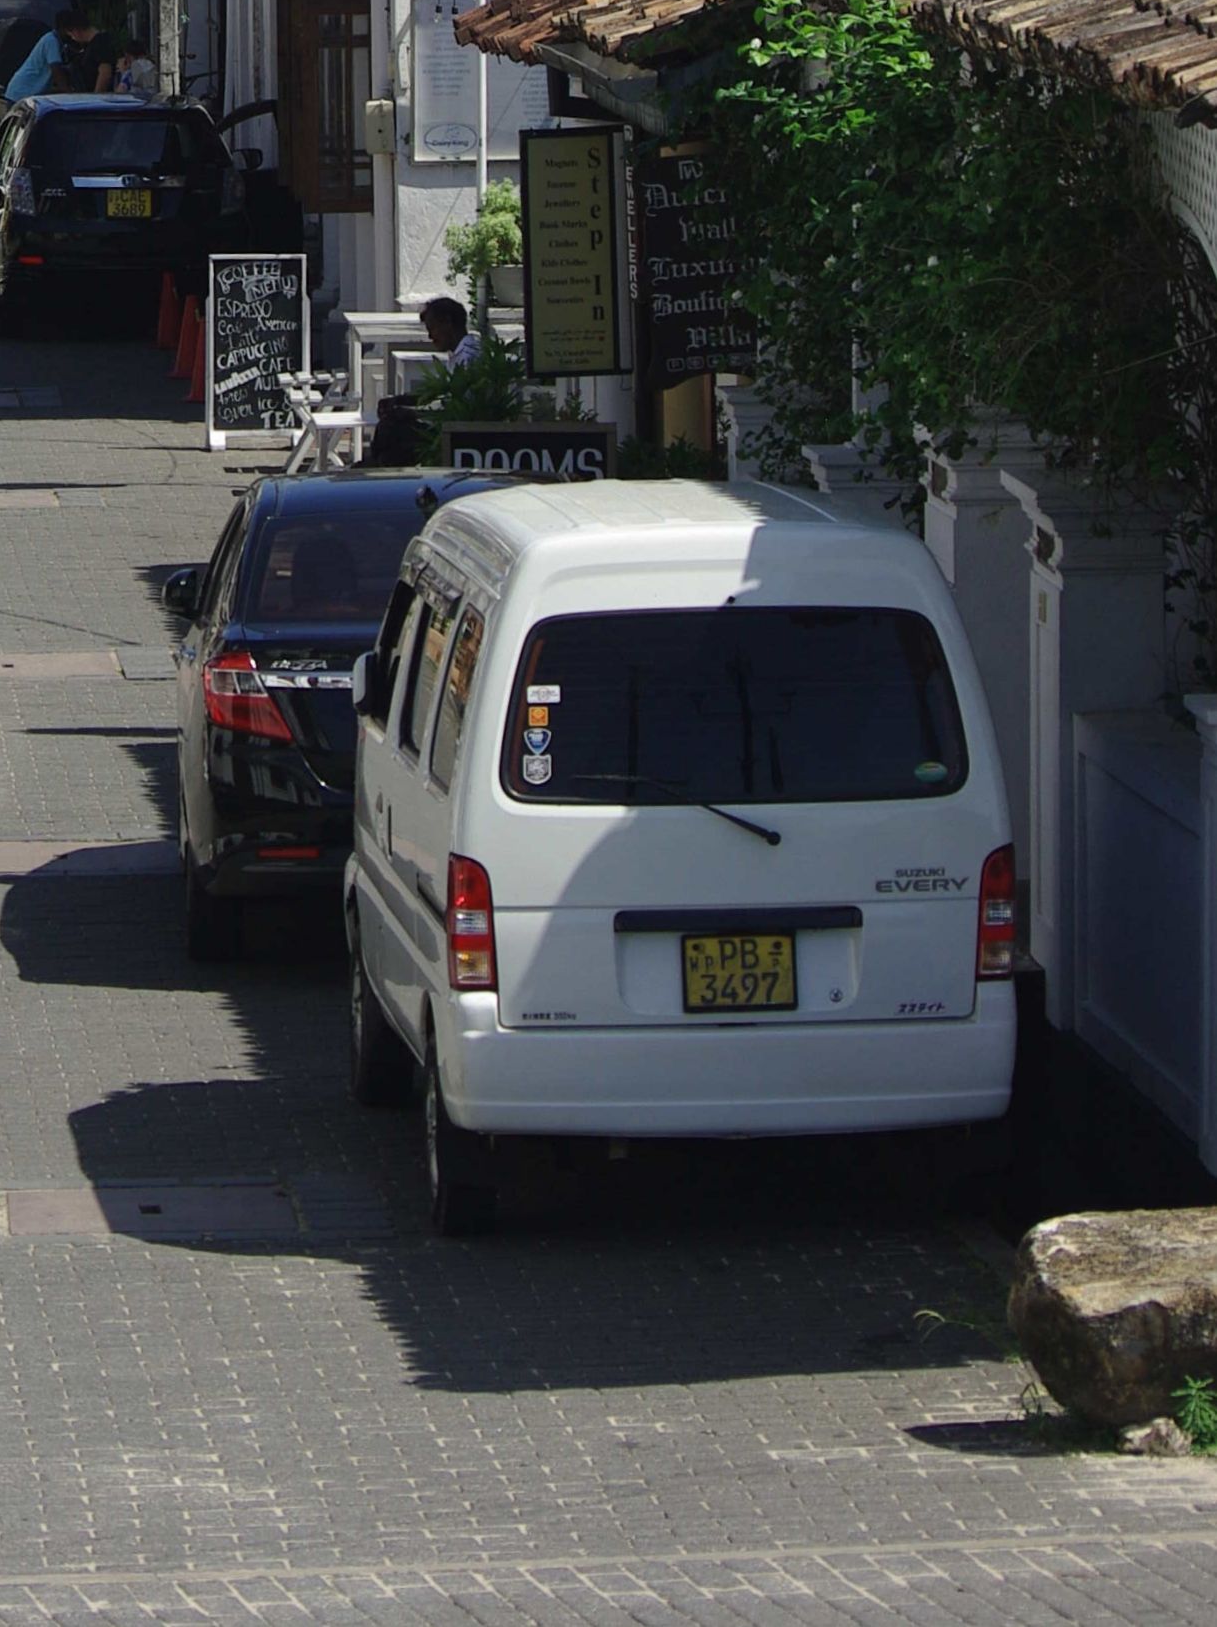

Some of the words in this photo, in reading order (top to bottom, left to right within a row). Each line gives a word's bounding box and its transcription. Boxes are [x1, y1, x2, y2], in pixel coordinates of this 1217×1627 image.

[587, 146, 604, 251] Step
[625, 160, 638, 299] EWELLERS
[223, 262, 282, 284] COFFEE
[253, 276, 291, 299] MENU
[217, 297, 273, 318] ESPRESSO
[217, 336, 288, 369] CAPPUCCINO
[260, 411, 296, 429] TEA
[895, 866, 945, 877] SUZUKI
[875, 876, 970, 892] EVERY
[718, 939, 759, 970] PB
[700, 972, 779, 1004] 3497
